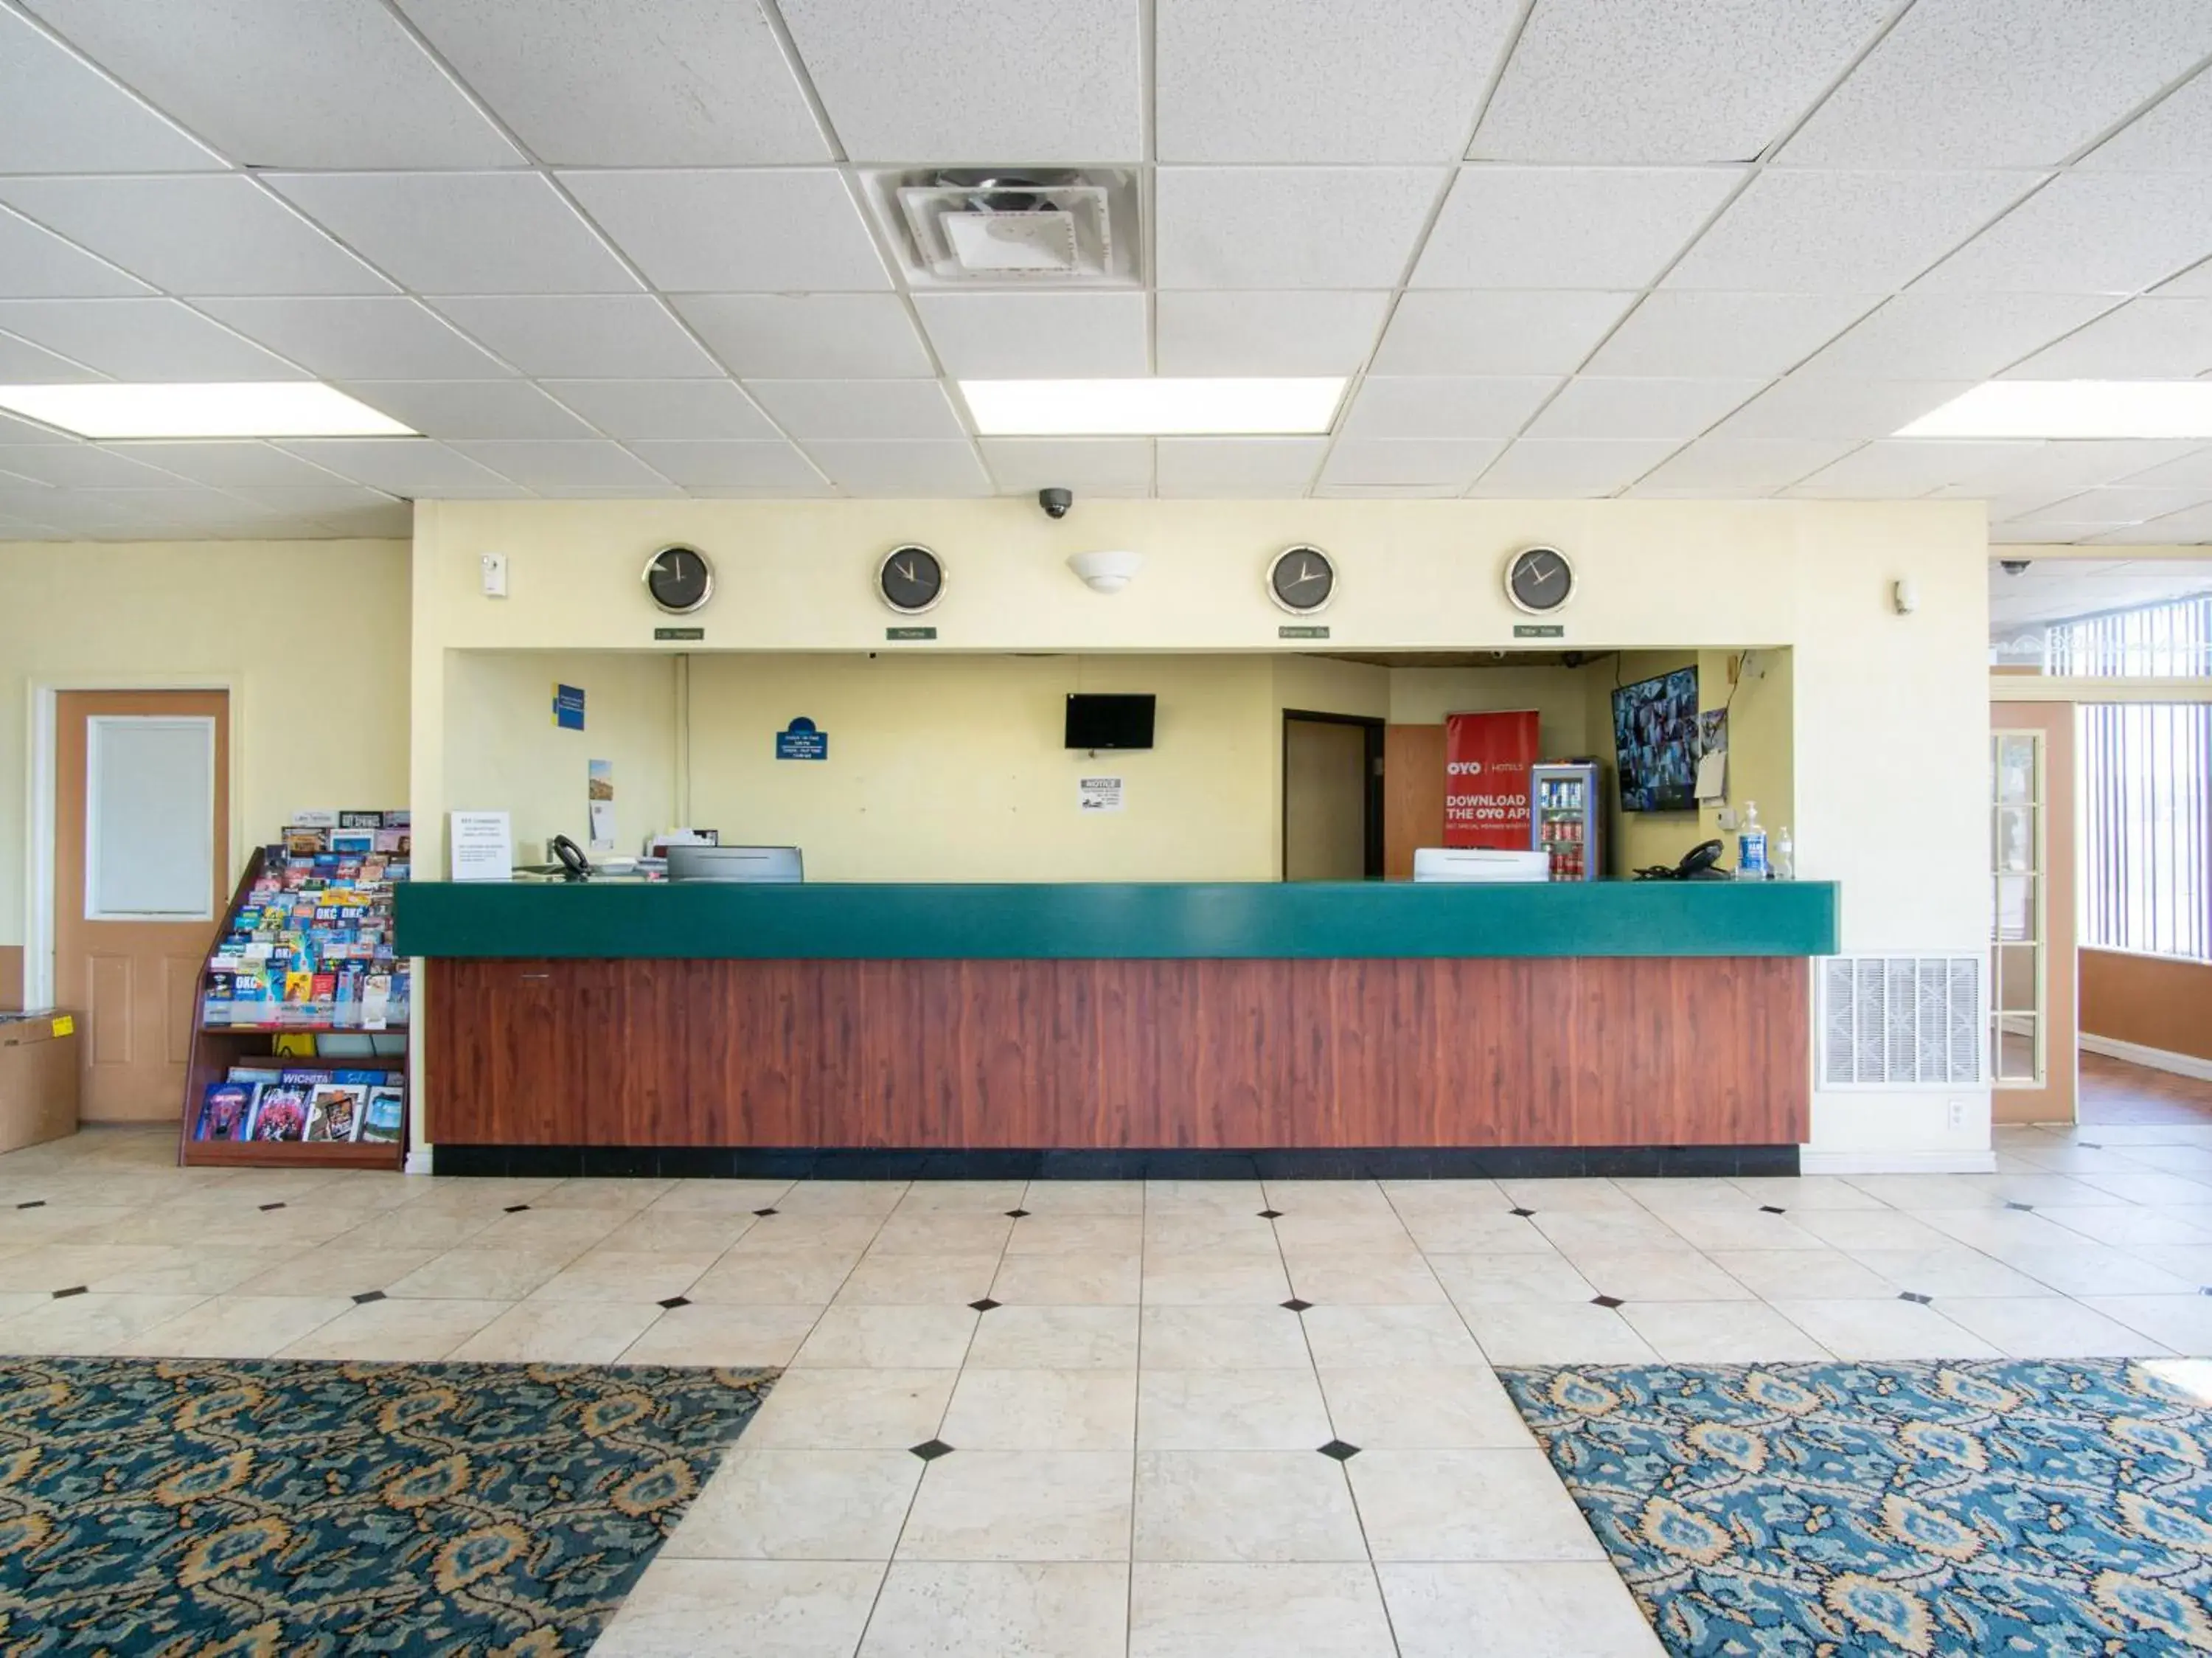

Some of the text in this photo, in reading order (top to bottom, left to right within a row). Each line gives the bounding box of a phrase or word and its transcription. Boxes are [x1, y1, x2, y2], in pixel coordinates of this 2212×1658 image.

[1447, 762, 1481, 774] OYO
[1447, 795, 1526, 807] DOWNLOAD
[1447, 808, 1474, 819] THE
[1476, 808, 1505, 819] OYO
[316, 908, 338, 920] OKC
[341, 907, 364, 918] OKC
[282, 1073, 328, 1084] WICHITA
